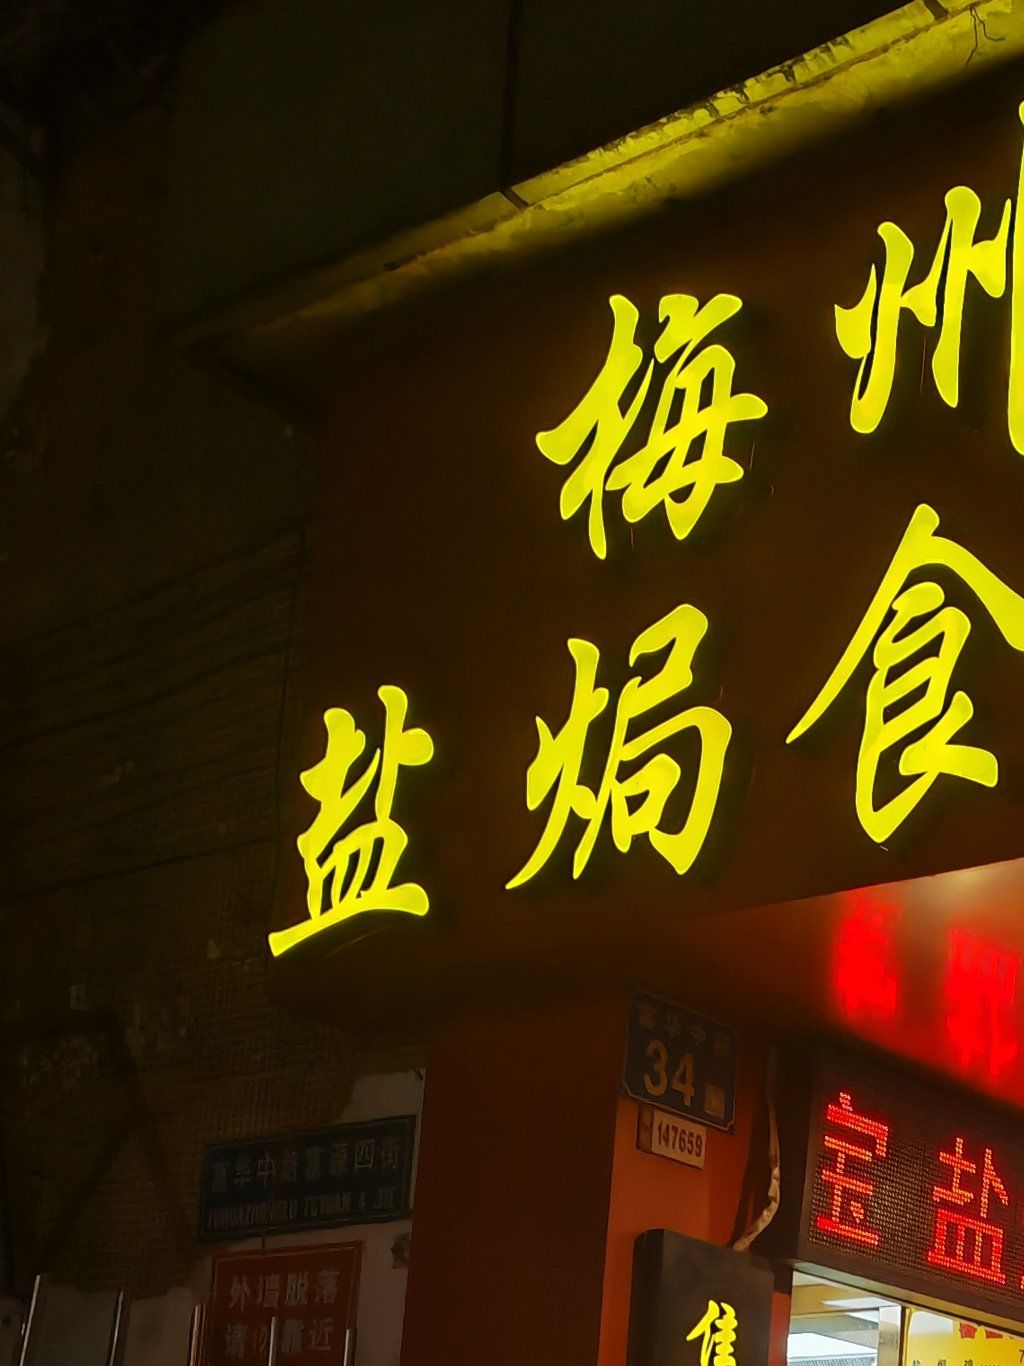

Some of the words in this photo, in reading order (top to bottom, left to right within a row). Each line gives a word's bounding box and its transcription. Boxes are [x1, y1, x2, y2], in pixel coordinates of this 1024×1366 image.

[643, 1039, 696, 1107] 34
[656, 1119, 704, 1158] 147659
[811, 1091, 889, 1247] 宝
